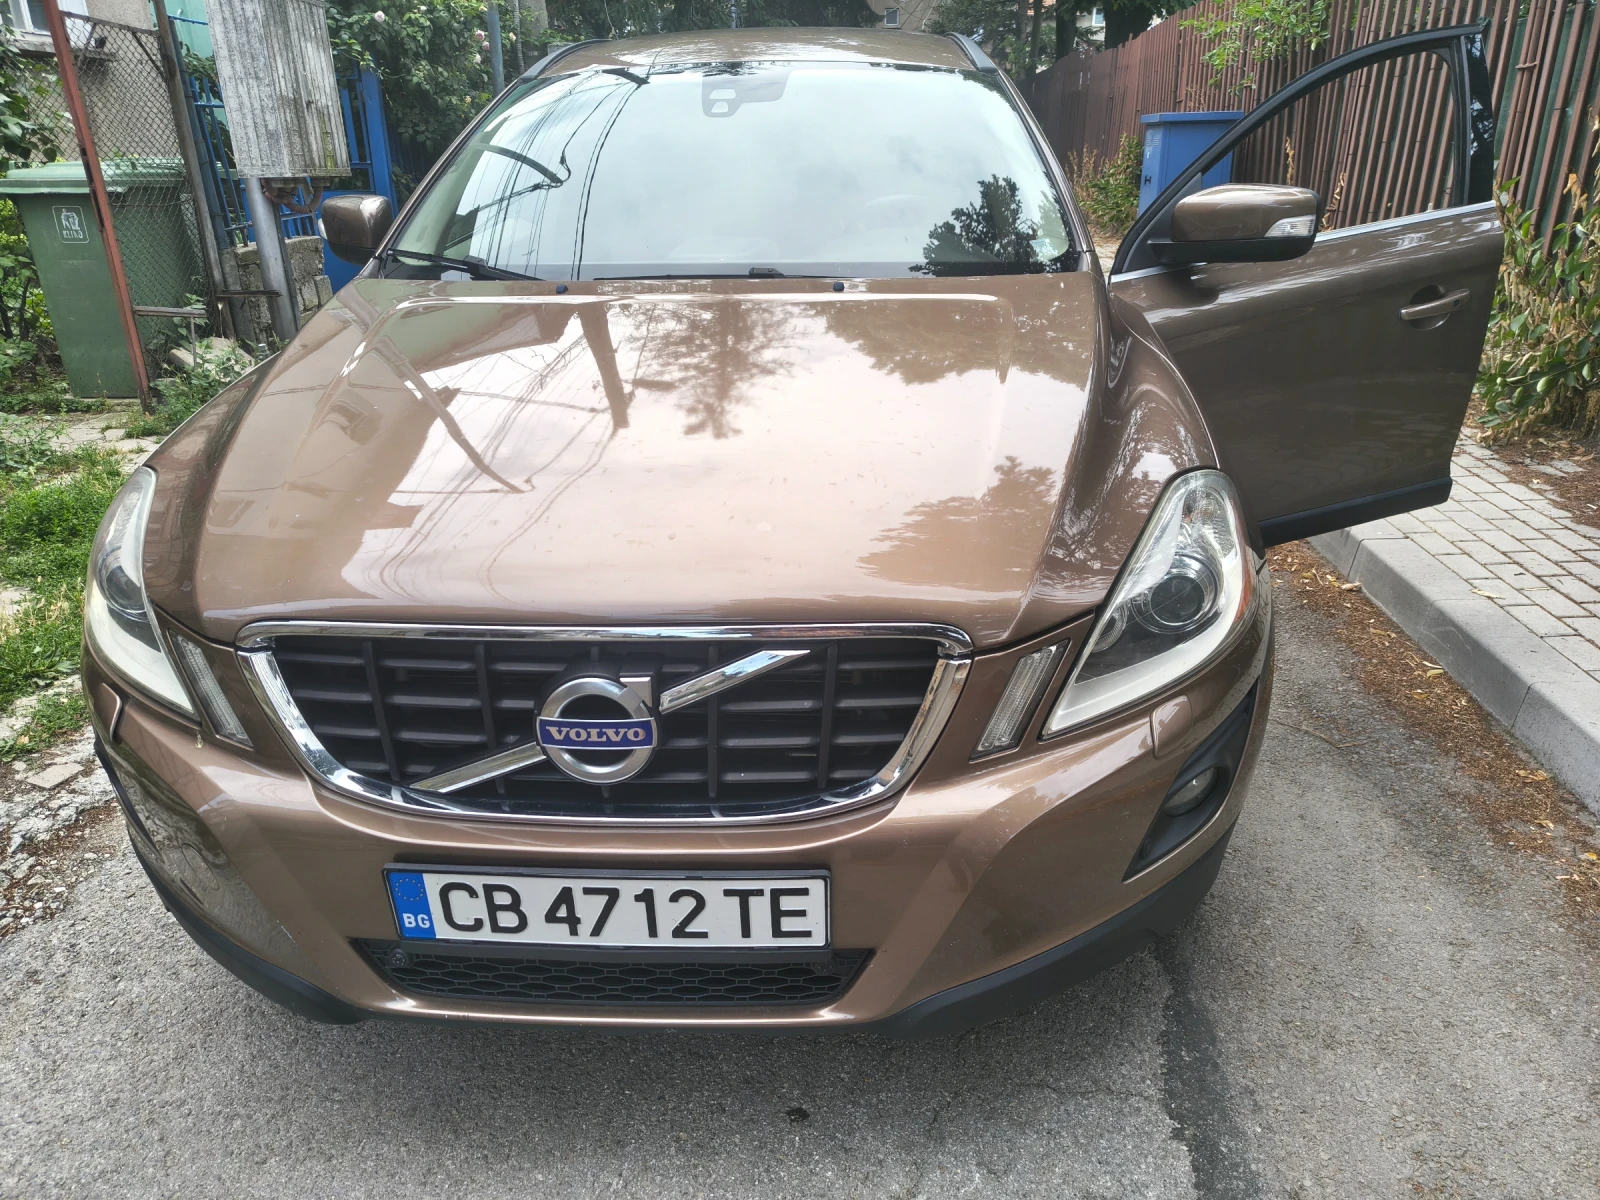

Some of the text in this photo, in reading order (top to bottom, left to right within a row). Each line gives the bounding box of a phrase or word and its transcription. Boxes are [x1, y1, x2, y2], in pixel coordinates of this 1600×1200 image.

[545, 726, 646, 742] VOLVO
[438, 881, 813, 939] CB 4712 TE
[402, 913, 431, 929] BG
